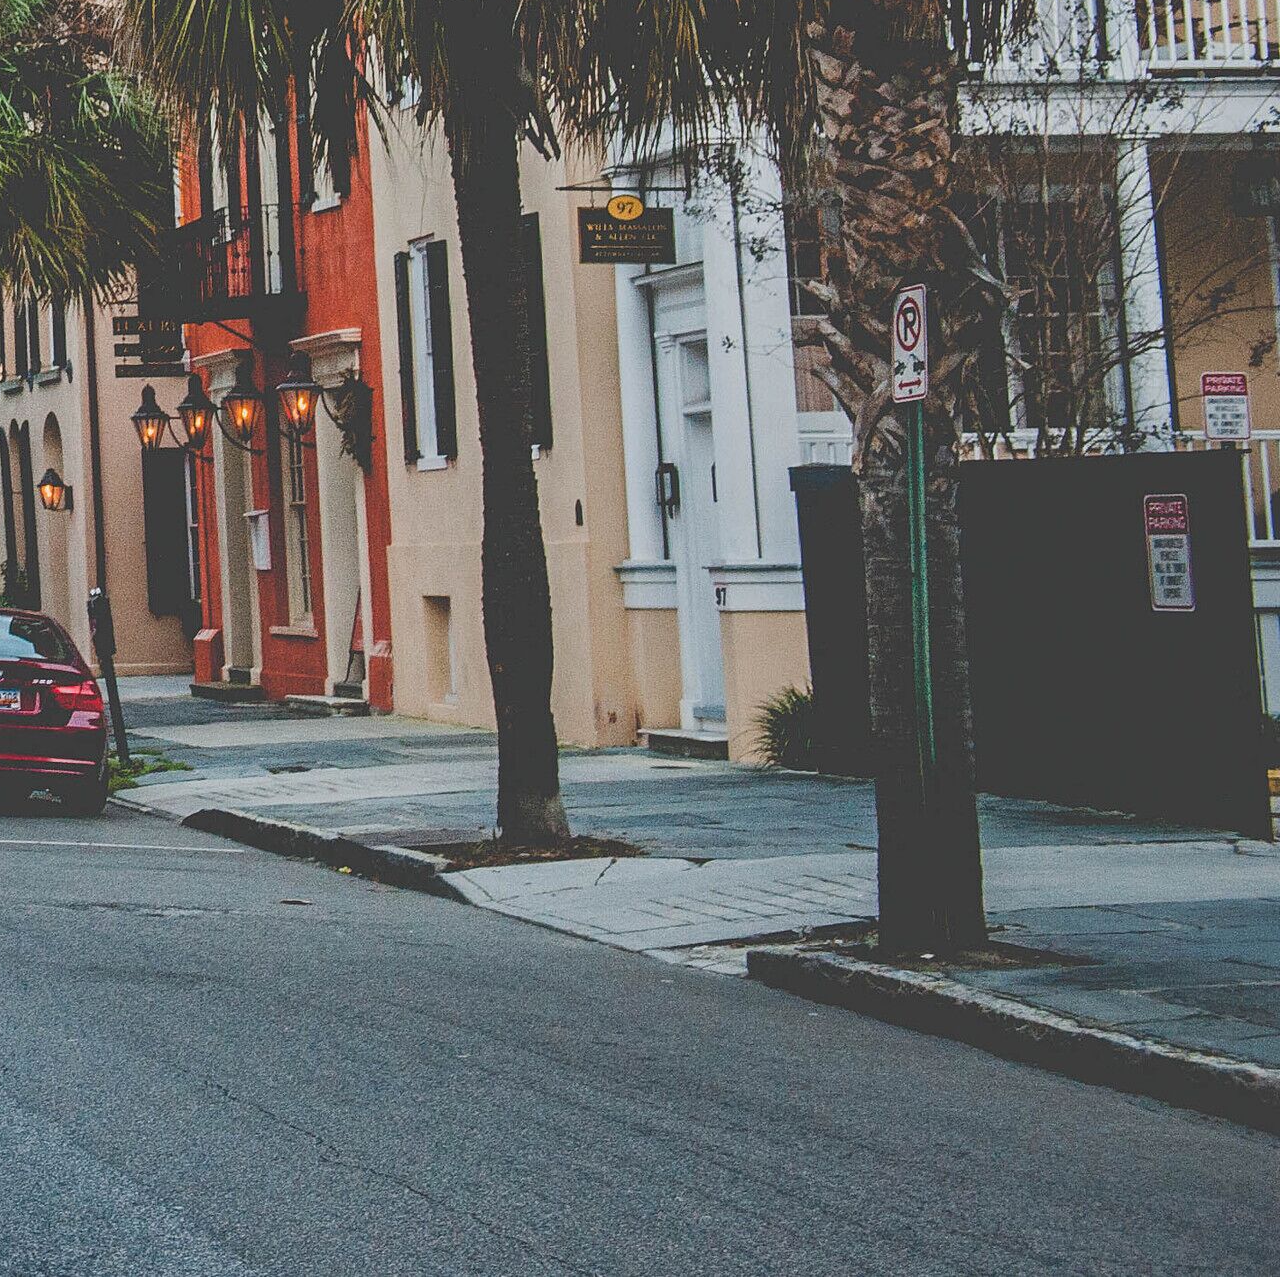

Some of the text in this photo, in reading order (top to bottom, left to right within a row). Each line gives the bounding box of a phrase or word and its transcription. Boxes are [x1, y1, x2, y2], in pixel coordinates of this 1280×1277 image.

[616, 201, 634, 214] 97
[1205, 376, 1244, 384] PRIVATE
[1148, 501, 1183, 514] PRIVATE
[1148, 515, 1186, 529] PARKING
[715, 587, 726, 606] 97
